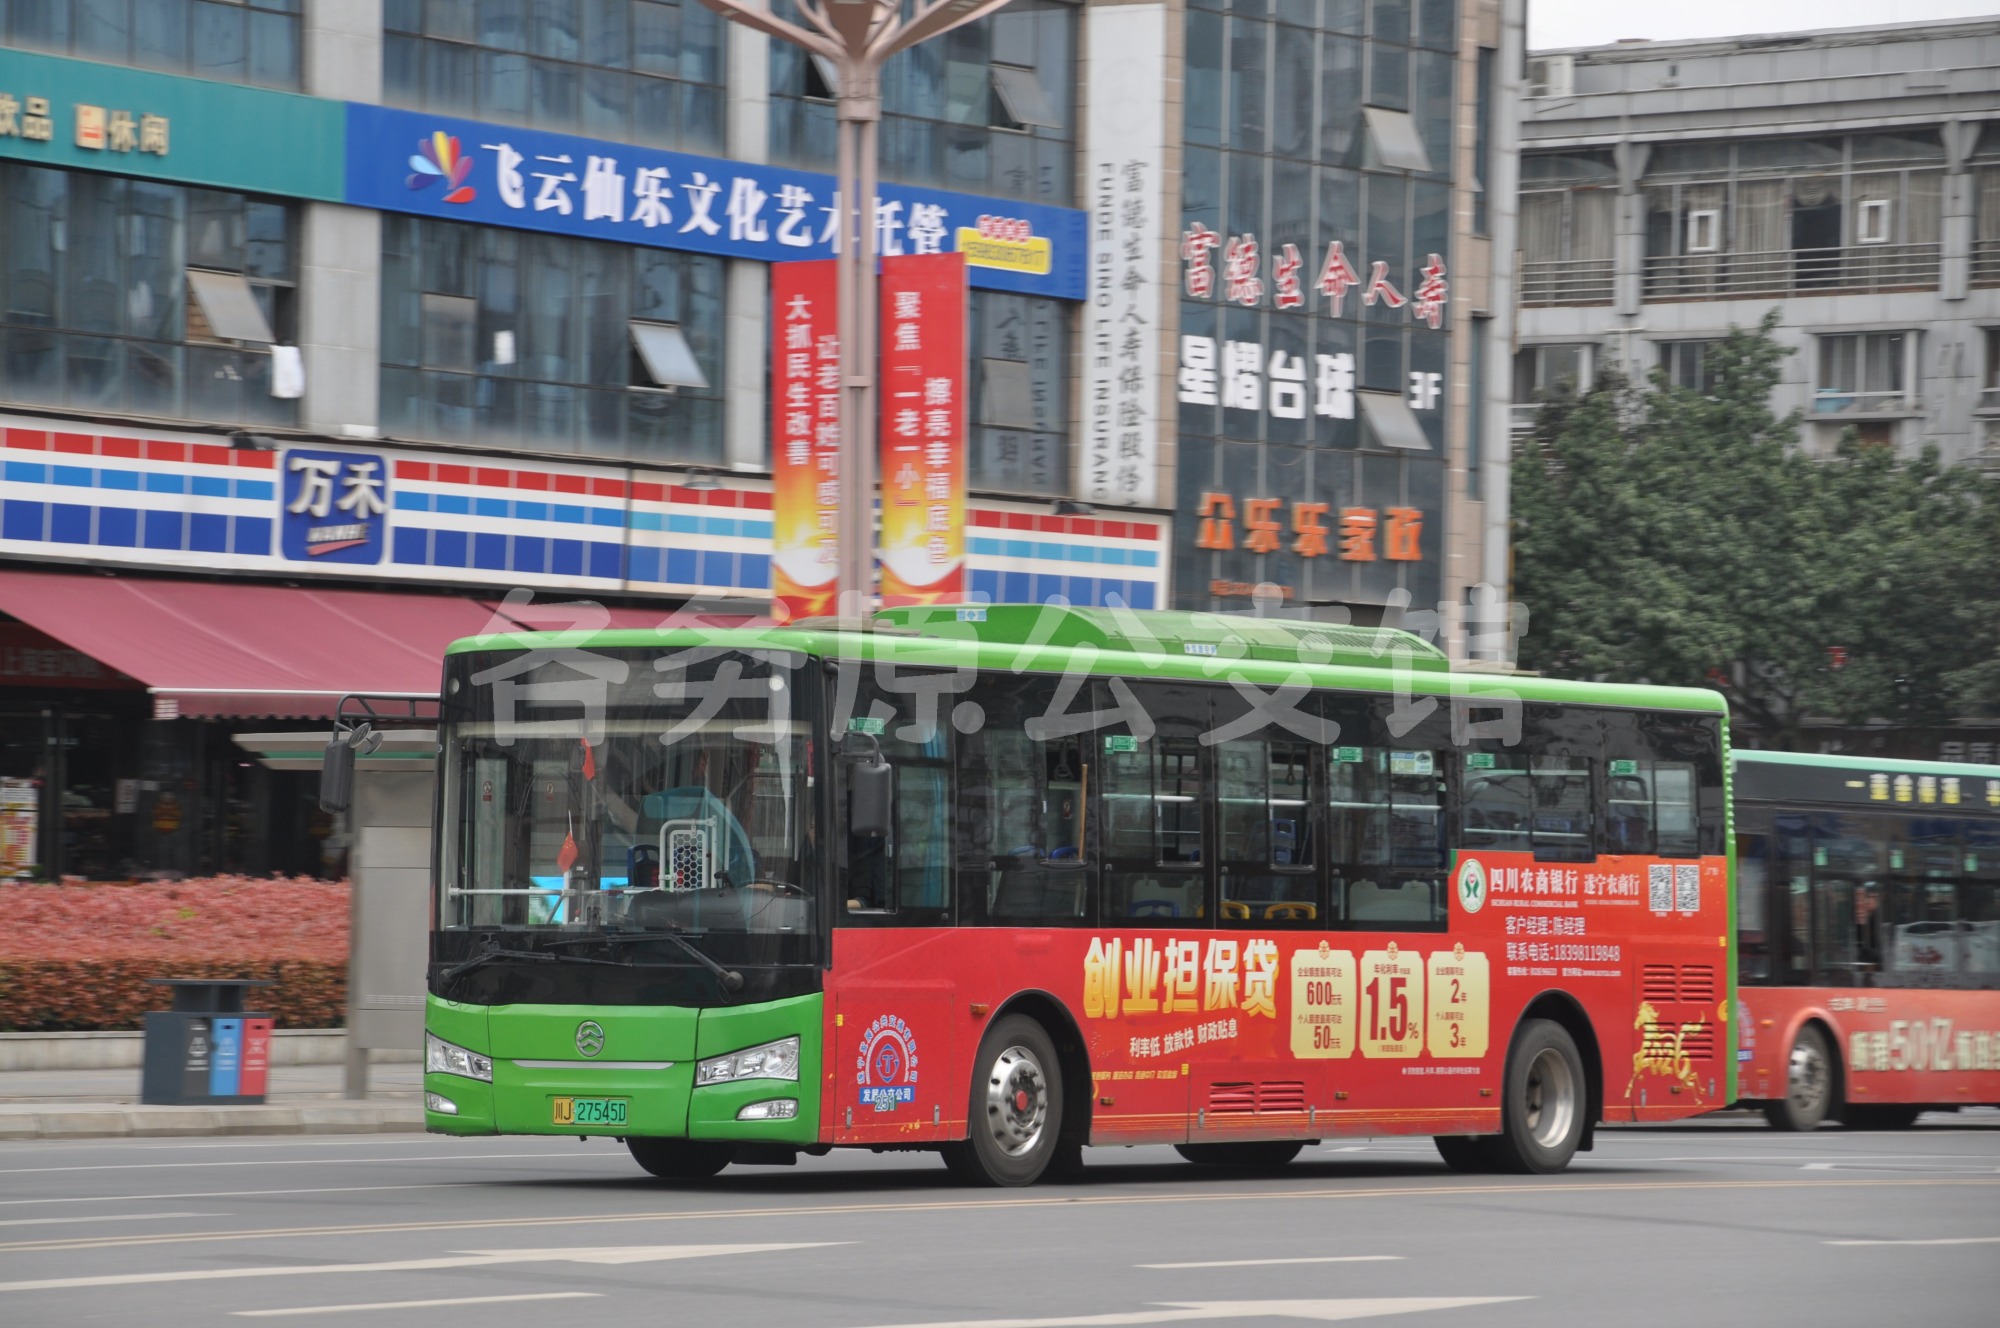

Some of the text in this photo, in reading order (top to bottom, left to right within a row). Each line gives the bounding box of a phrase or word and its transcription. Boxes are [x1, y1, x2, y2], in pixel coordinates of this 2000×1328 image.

[109, 110, 169, 156] 休闲
[1180, 221, 1449, 330] 富德生命人寿
[785, 294, 812, 466] 大抓民生改善
[1178, 335, 1356, 419] 星熠台球
[286, 457, 390, 519] 万禾
[924, 377, 952, 564] 擦亮幸福底色
[1195, 492, 1424, 561] 众乐乐家政
[1489, 867, 1640, 895] 四川农商银行 遂宁农商行
[1083, 936, 1279, 1019] 创业担保贷
[1129, 1018, 1238, 1058] 利率低 放款快 财政贴息
